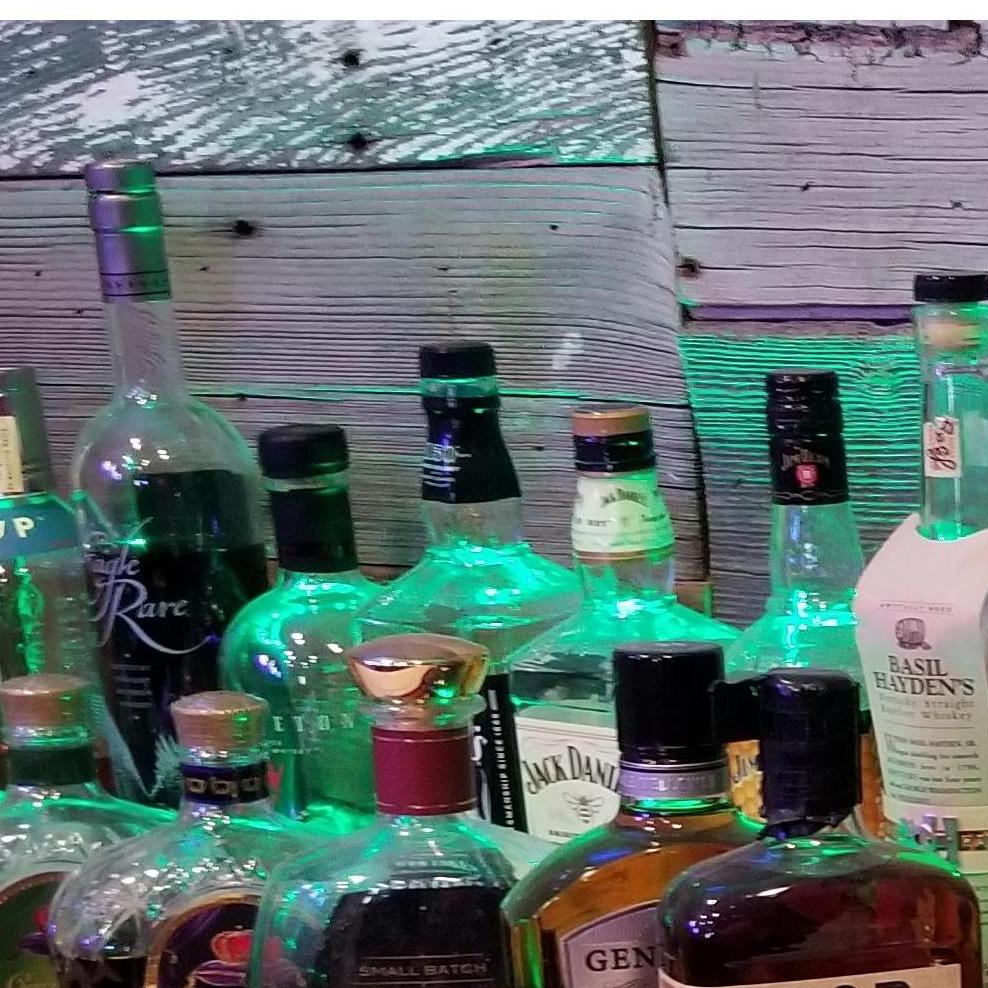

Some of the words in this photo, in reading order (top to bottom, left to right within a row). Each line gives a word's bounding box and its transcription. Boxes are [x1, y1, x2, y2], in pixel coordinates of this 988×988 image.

[94, 578, 208, 655] Rare
[888, 655, 948, 676] BASIL
[873, 671, 976, 696] HAYDEN'S
[522, 753, 568, 795] JACK
